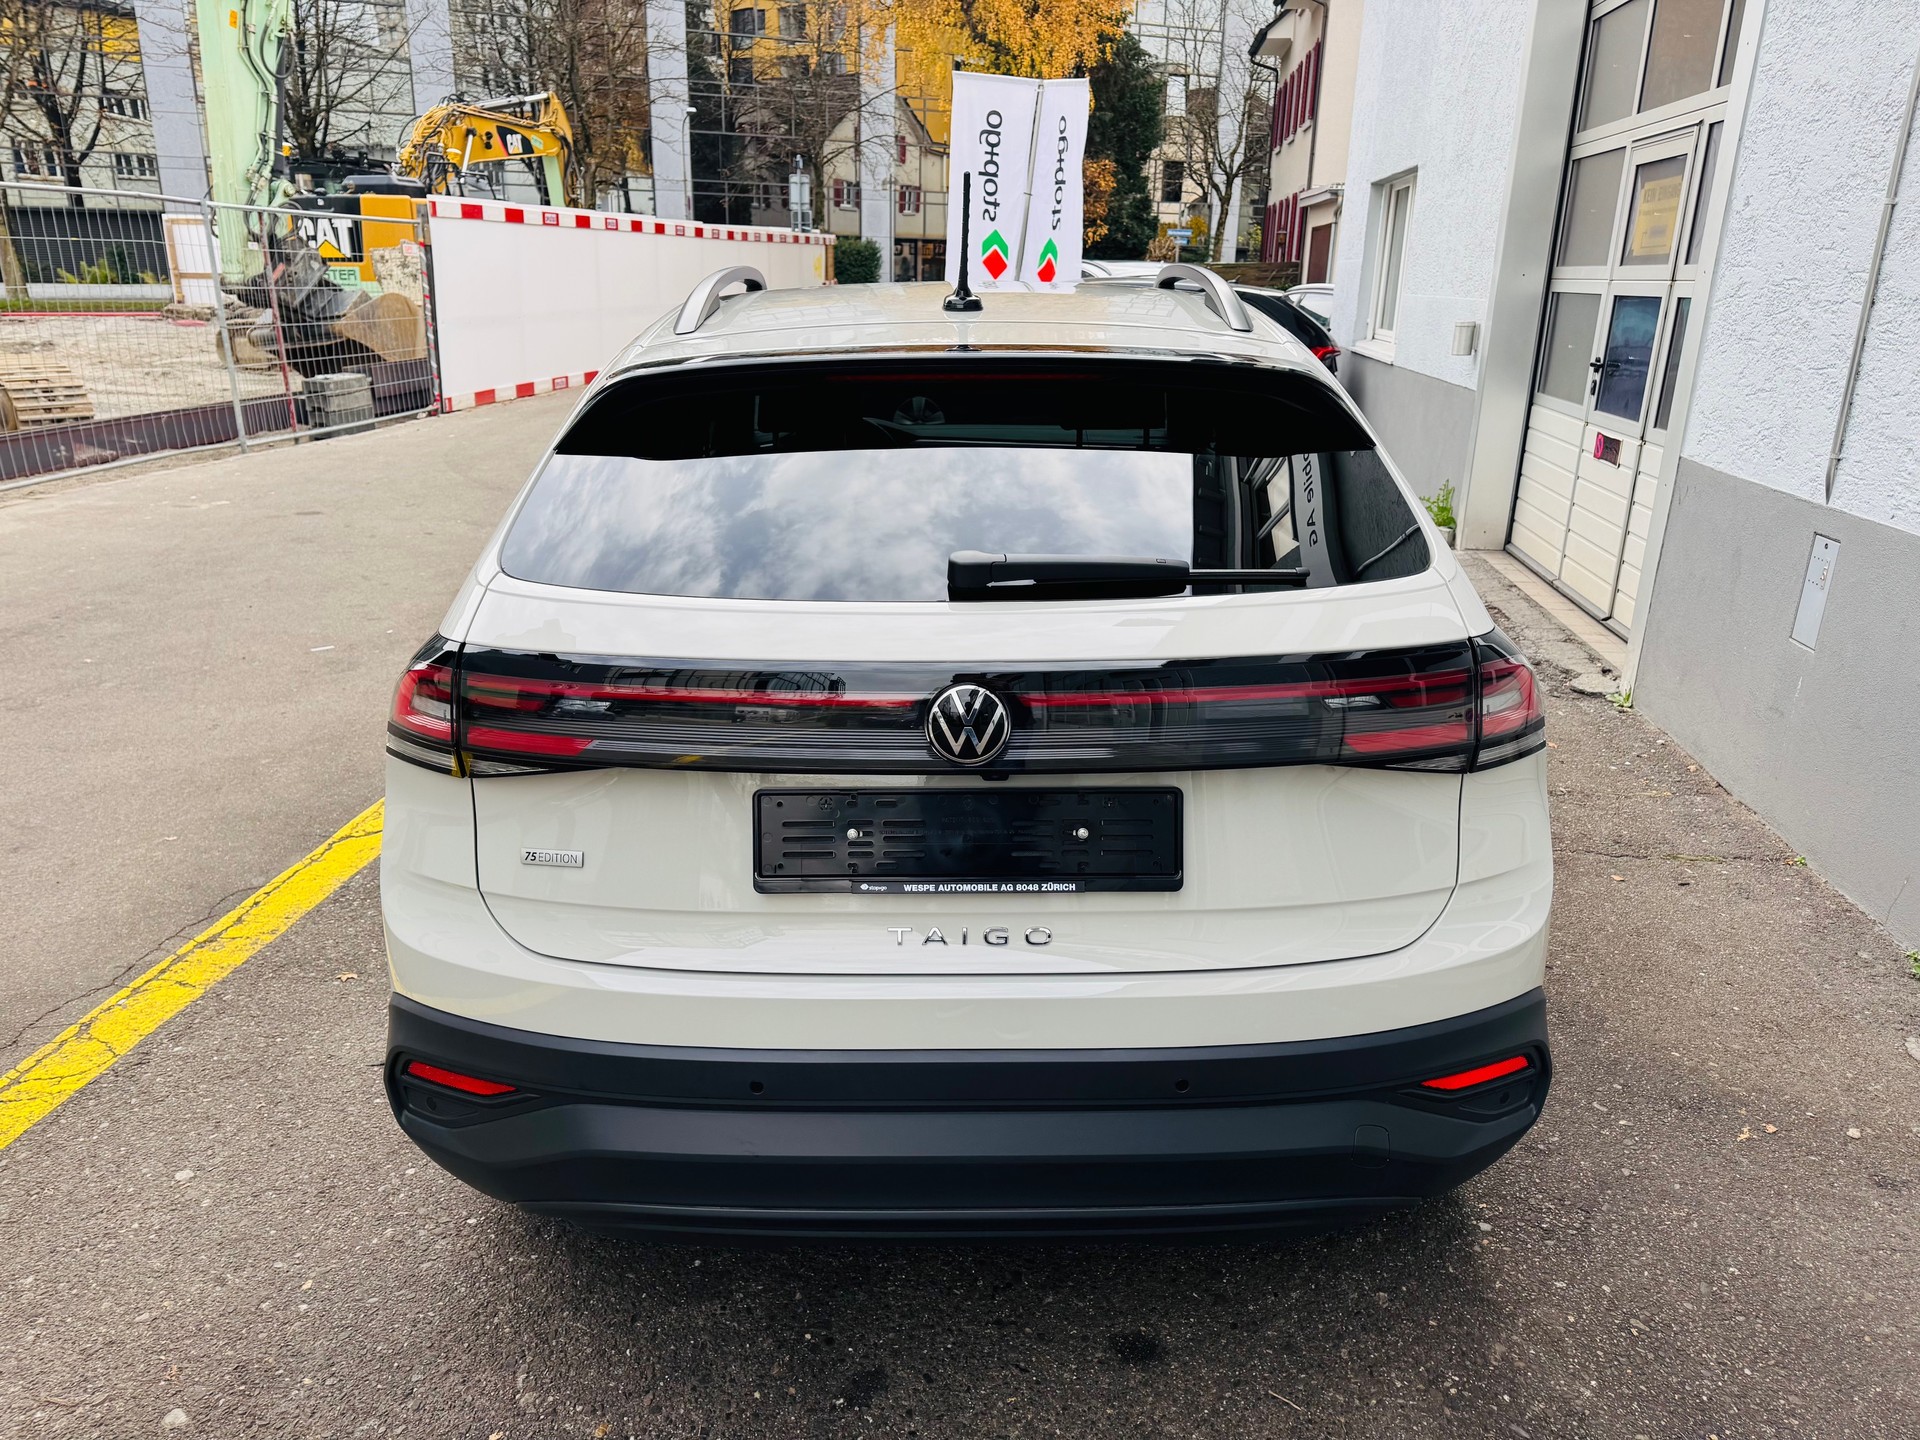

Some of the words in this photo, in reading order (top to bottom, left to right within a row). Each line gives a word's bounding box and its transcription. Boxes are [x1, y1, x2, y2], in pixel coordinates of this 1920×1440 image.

[506, 133, 523, 155] CAT
[298, 217, 353, 258] CAT
[525, 851, 537, 862] 75
[538, 852, 578, 864] EDITION
[903, 883, 935, 892] WESPE
[938, 883, 998, 892] AUTOMOBILE
[1000, 883, 1014, 892] AG
[1016, 883, 1039, 891] 8048
[1041, 882, 1076, 891] ZÜRICH
[887, 926, 1053, 946] TAIGO
